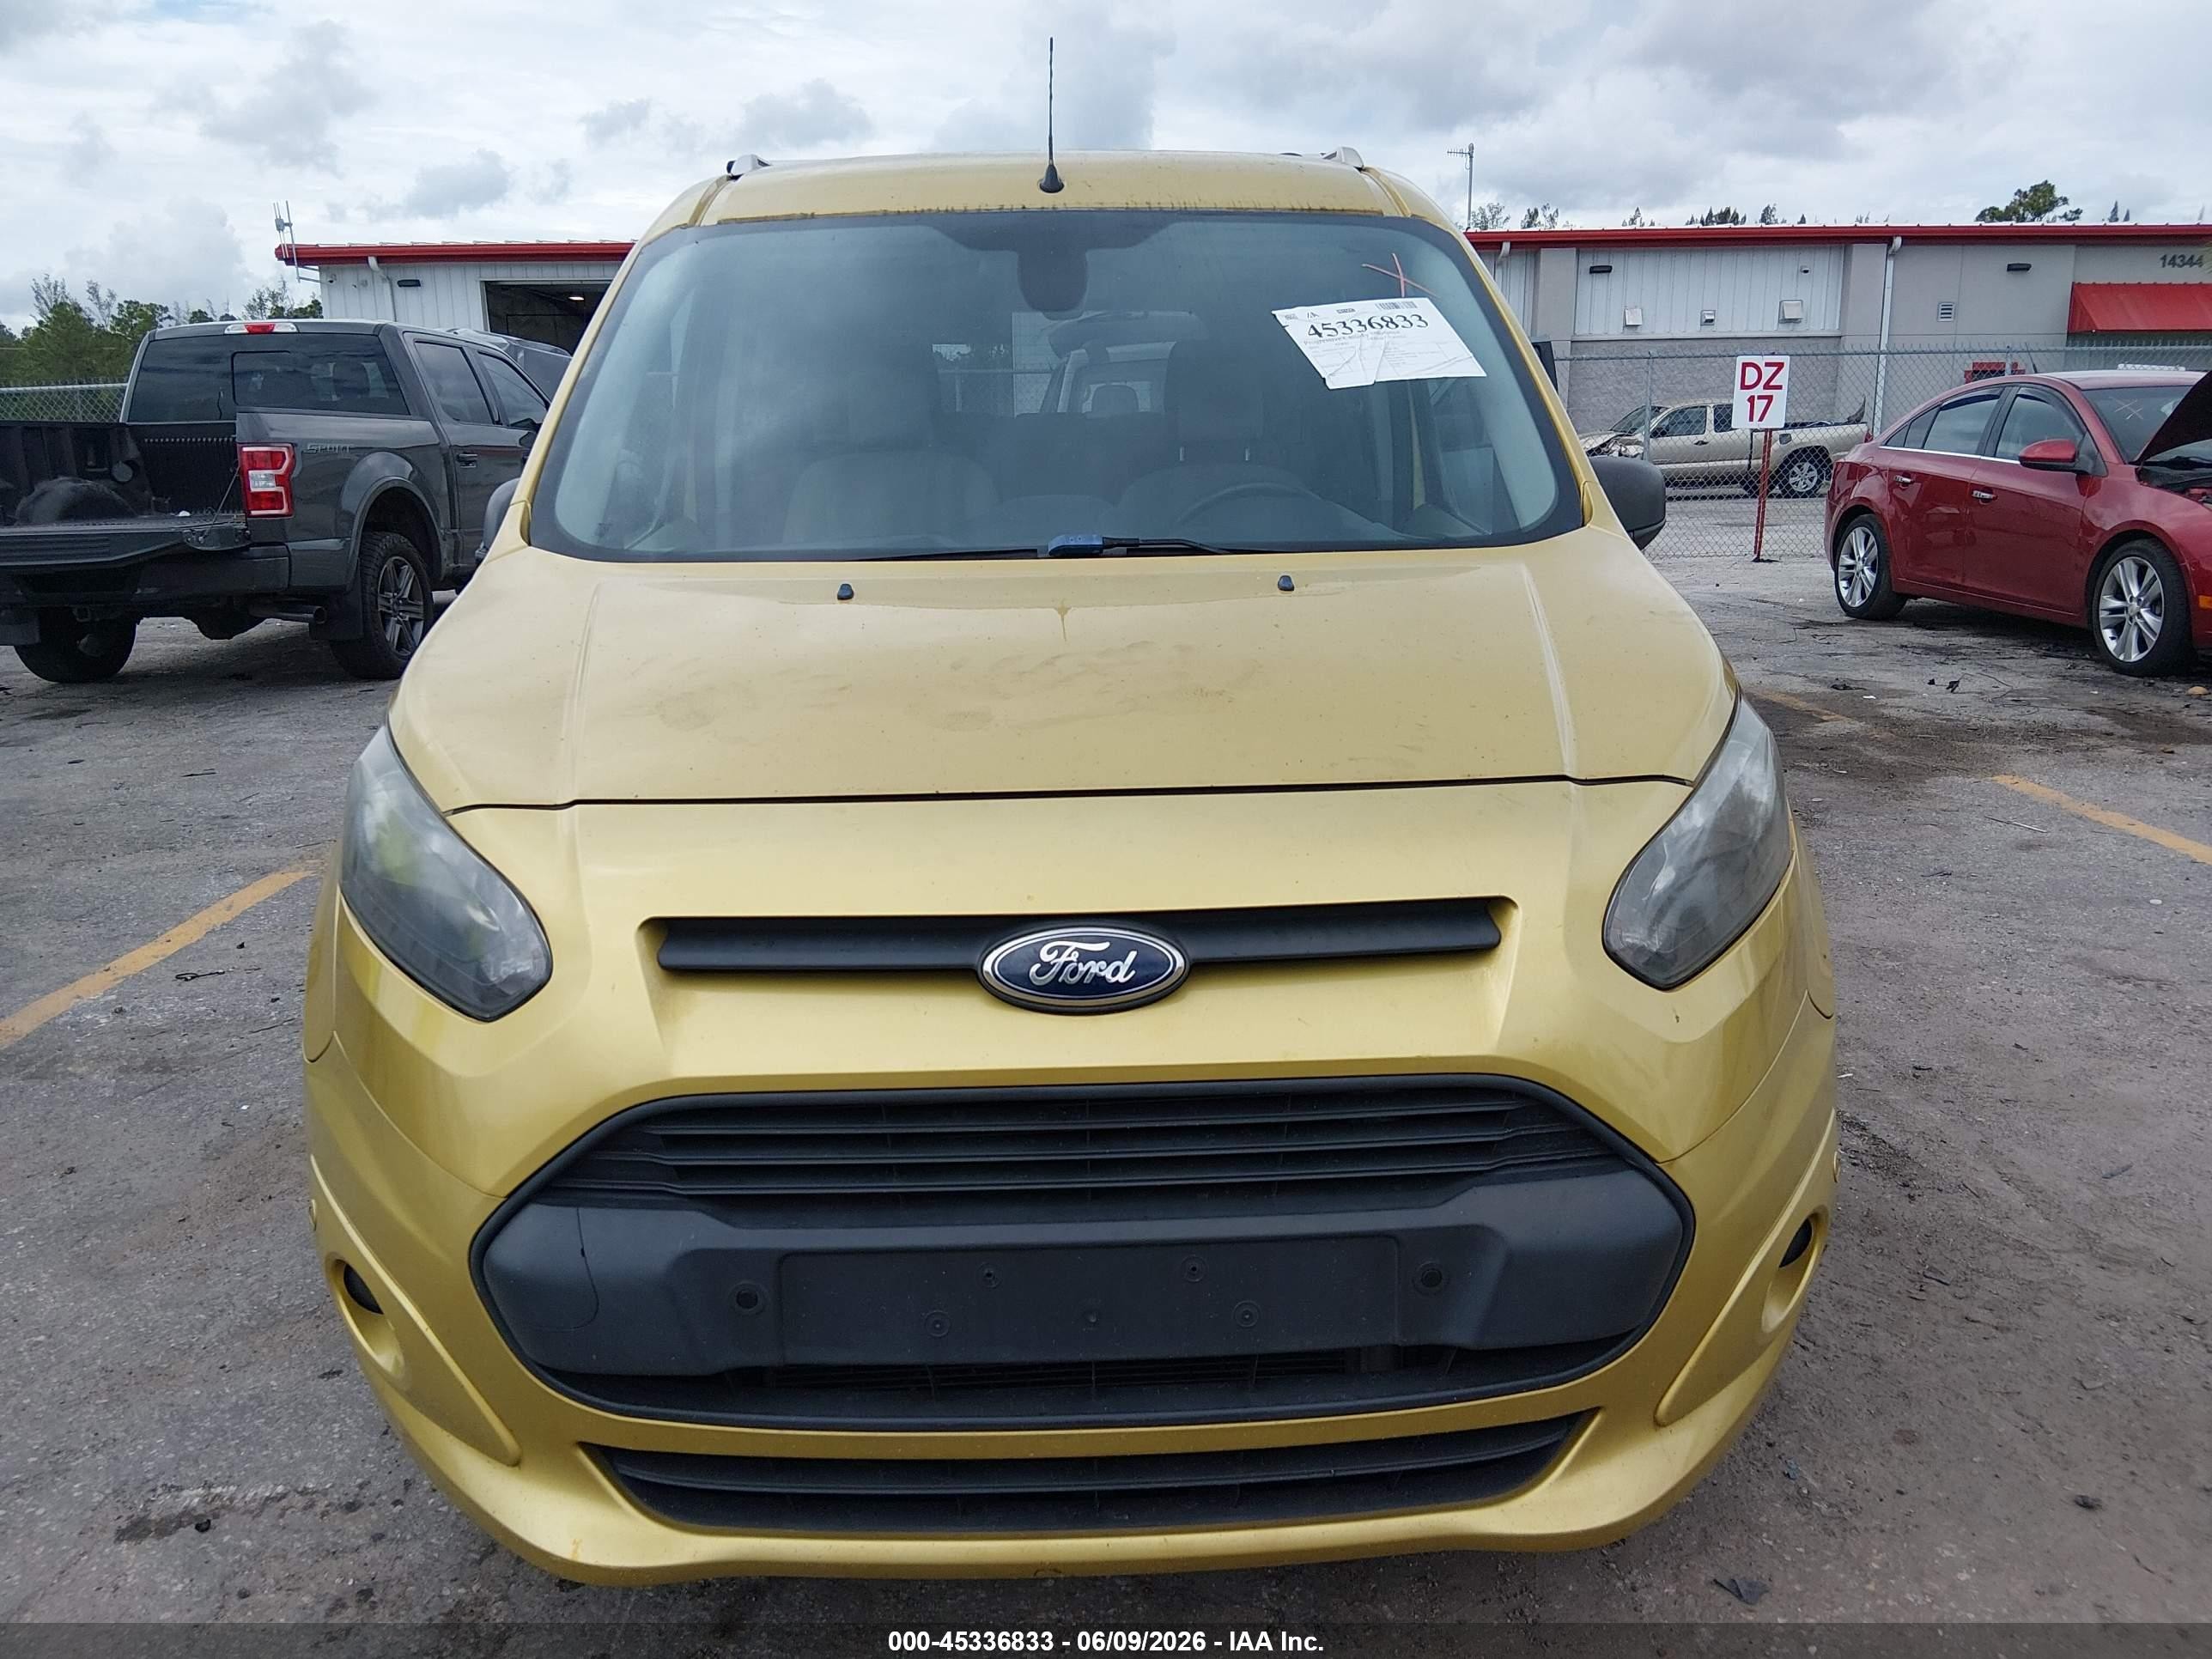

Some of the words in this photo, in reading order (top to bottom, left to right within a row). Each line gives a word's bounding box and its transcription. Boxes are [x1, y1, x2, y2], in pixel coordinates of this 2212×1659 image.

[1307, 313, 1429, 338] 45336833
[1740, 362, 1785, 391] DZ
[1747, 394, 1774, 422] 17
[1029, 940, 1139, 986] Ford
